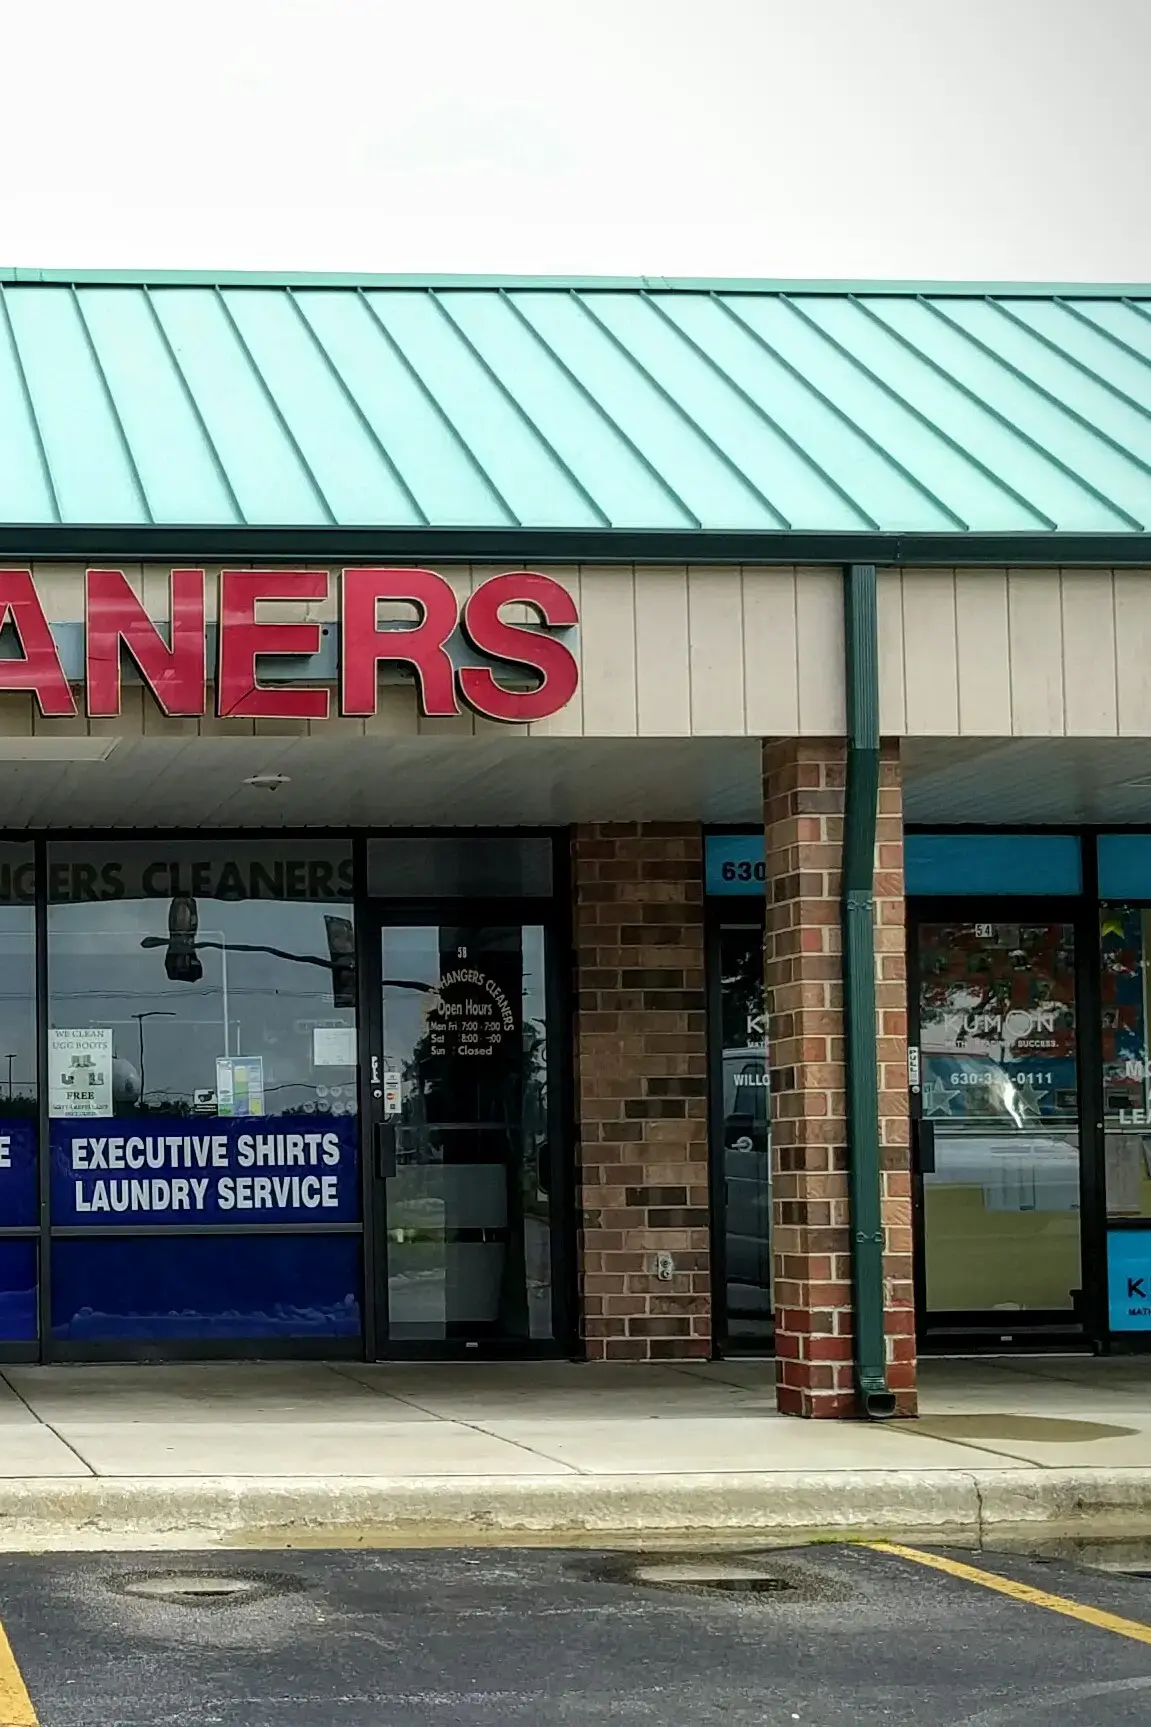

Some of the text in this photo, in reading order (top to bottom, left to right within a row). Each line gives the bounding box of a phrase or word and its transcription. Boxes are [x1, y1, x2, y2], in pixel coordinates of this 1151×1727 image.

[142, 859, 354, 900] CLEANERS
[722, 861, 766, 881] 630
[975, 924, 992, 937] 54
[438, 998, 462, 1020] Open
[465, 998, 493, 1016] Hours
[439, 968, 486, 989] HANGERS
[485, 979, 515, 1032] CLEANERS
[944, 1009, 1054, 1037] KUMON
[72, 1030, 104, 1038] CLEAN
[457, 1044, 493, 1056] Closed
[1125, 1060, 1151, 1078] M
[66, 1091, 95, 1100] FREE
[71, 1133, 340, 1169] EXECUTIVE SHIRTS
[75, 1176, 338, 1211] LAUNDRY SERVICE
